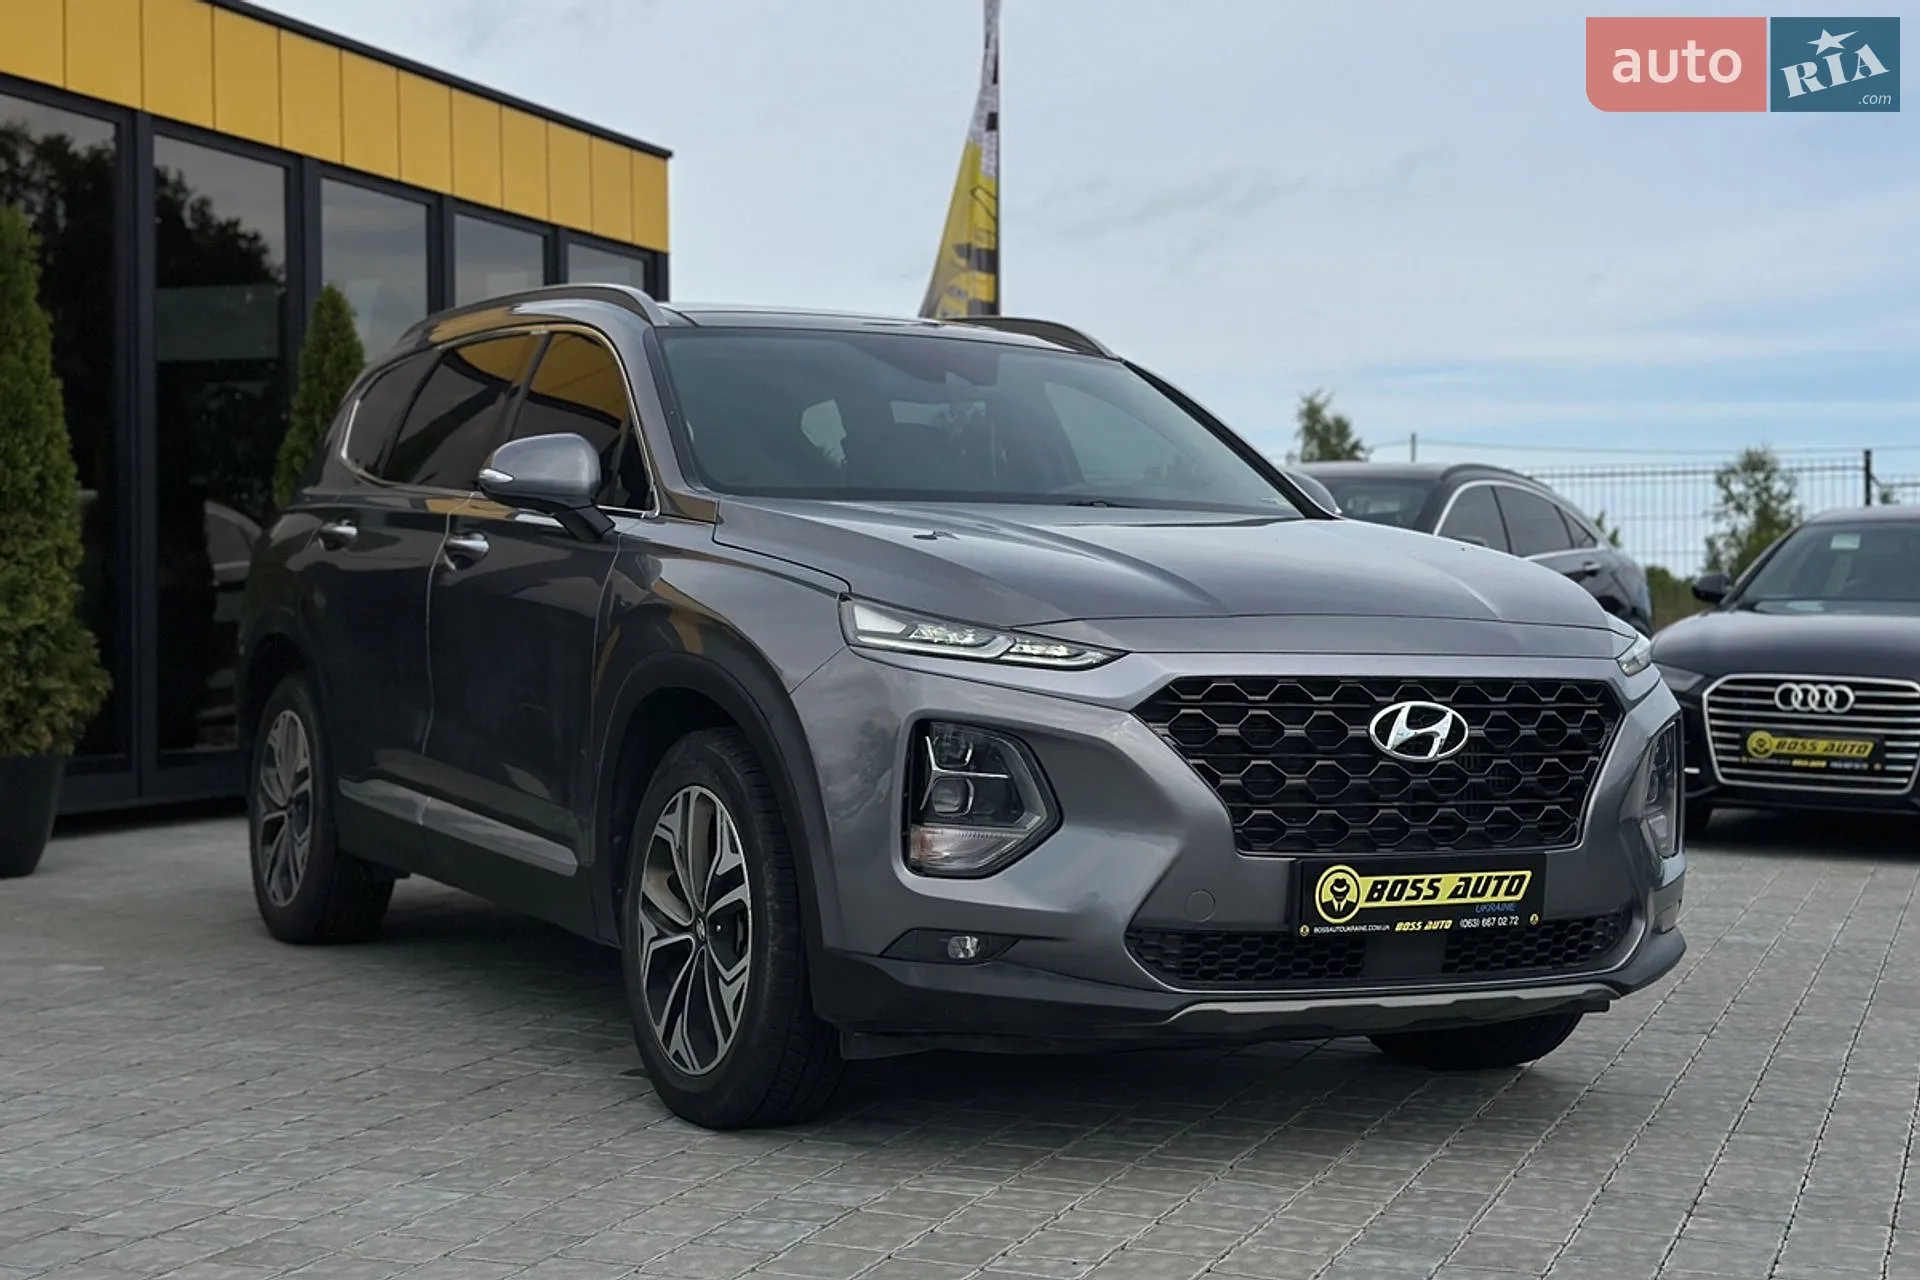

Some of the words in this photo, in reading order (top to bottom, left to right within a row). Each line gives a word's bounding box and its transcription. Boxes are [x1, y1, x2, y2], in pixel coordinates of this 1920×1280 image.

[1775, 740, 1818, 753] BOSS
[1822, 743, 1870, 755] AUTO
[1366, 878, 1443, 903] BOSS
[1446, 874, 1528, 900] AUTO
[1475, 903, 1517, 913] UKRAINE
[1395, 921, 1422, 932] BOSS
[1423, 920, 1453, 931] AUTO
